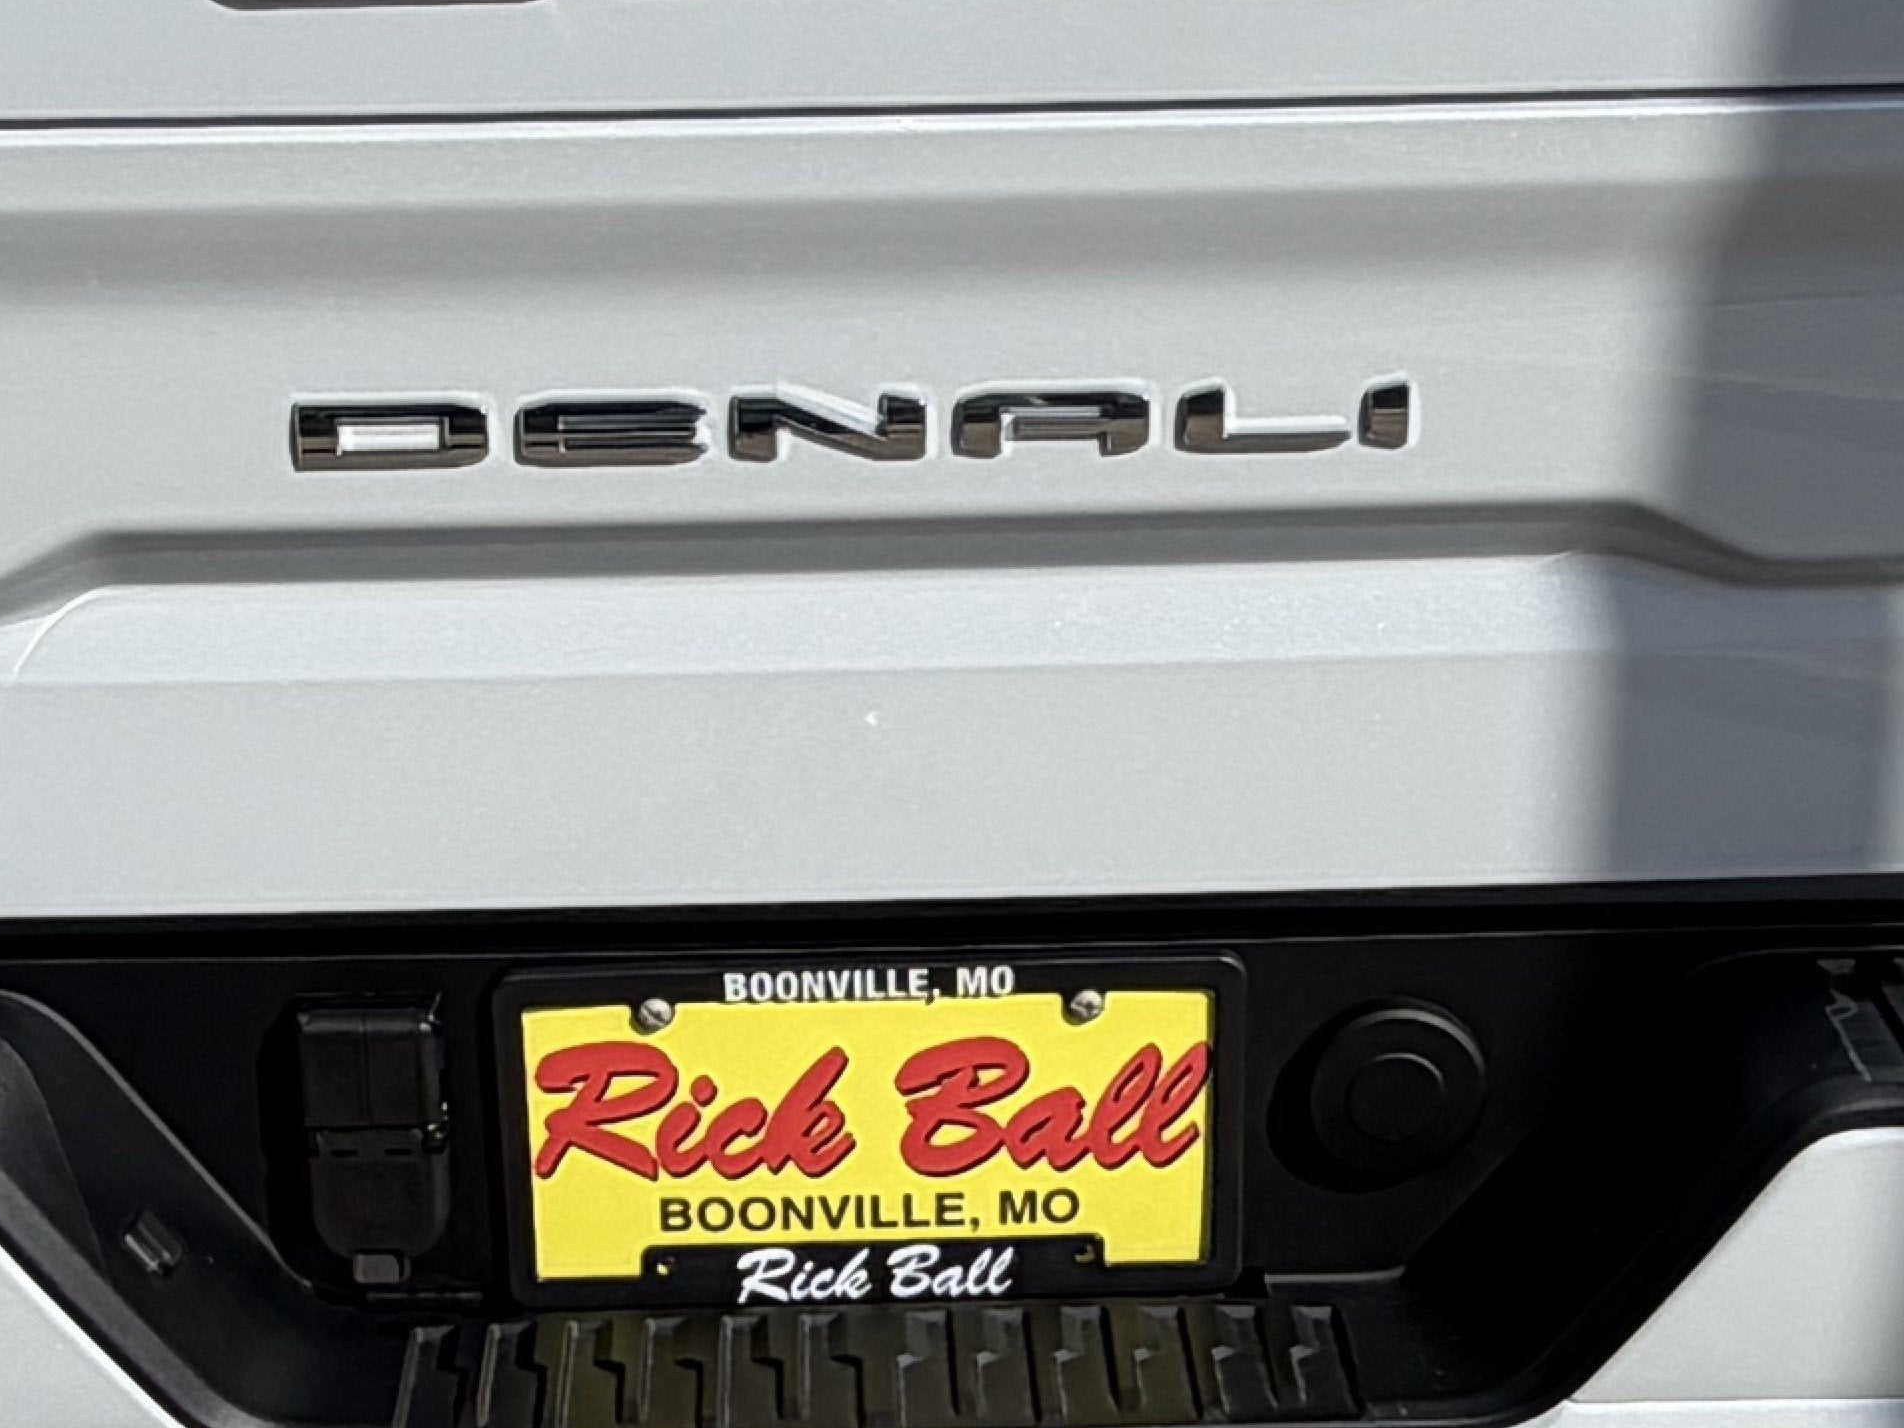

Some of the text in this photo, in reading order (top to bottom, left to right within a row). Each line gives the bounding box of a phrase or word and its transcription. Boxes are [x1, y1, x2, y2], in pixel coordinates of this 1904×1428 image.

[289, 375, 1416, 472] DENALI
[722, 966, 1016, 1005] BOONVILLE, MO
[534, 1036, 1213, 1182] Rick Ball
[657, 1189, 1081, 1234] BOONVILLE, MO
[736, 1245, 1015, 1304] Rick Ball
